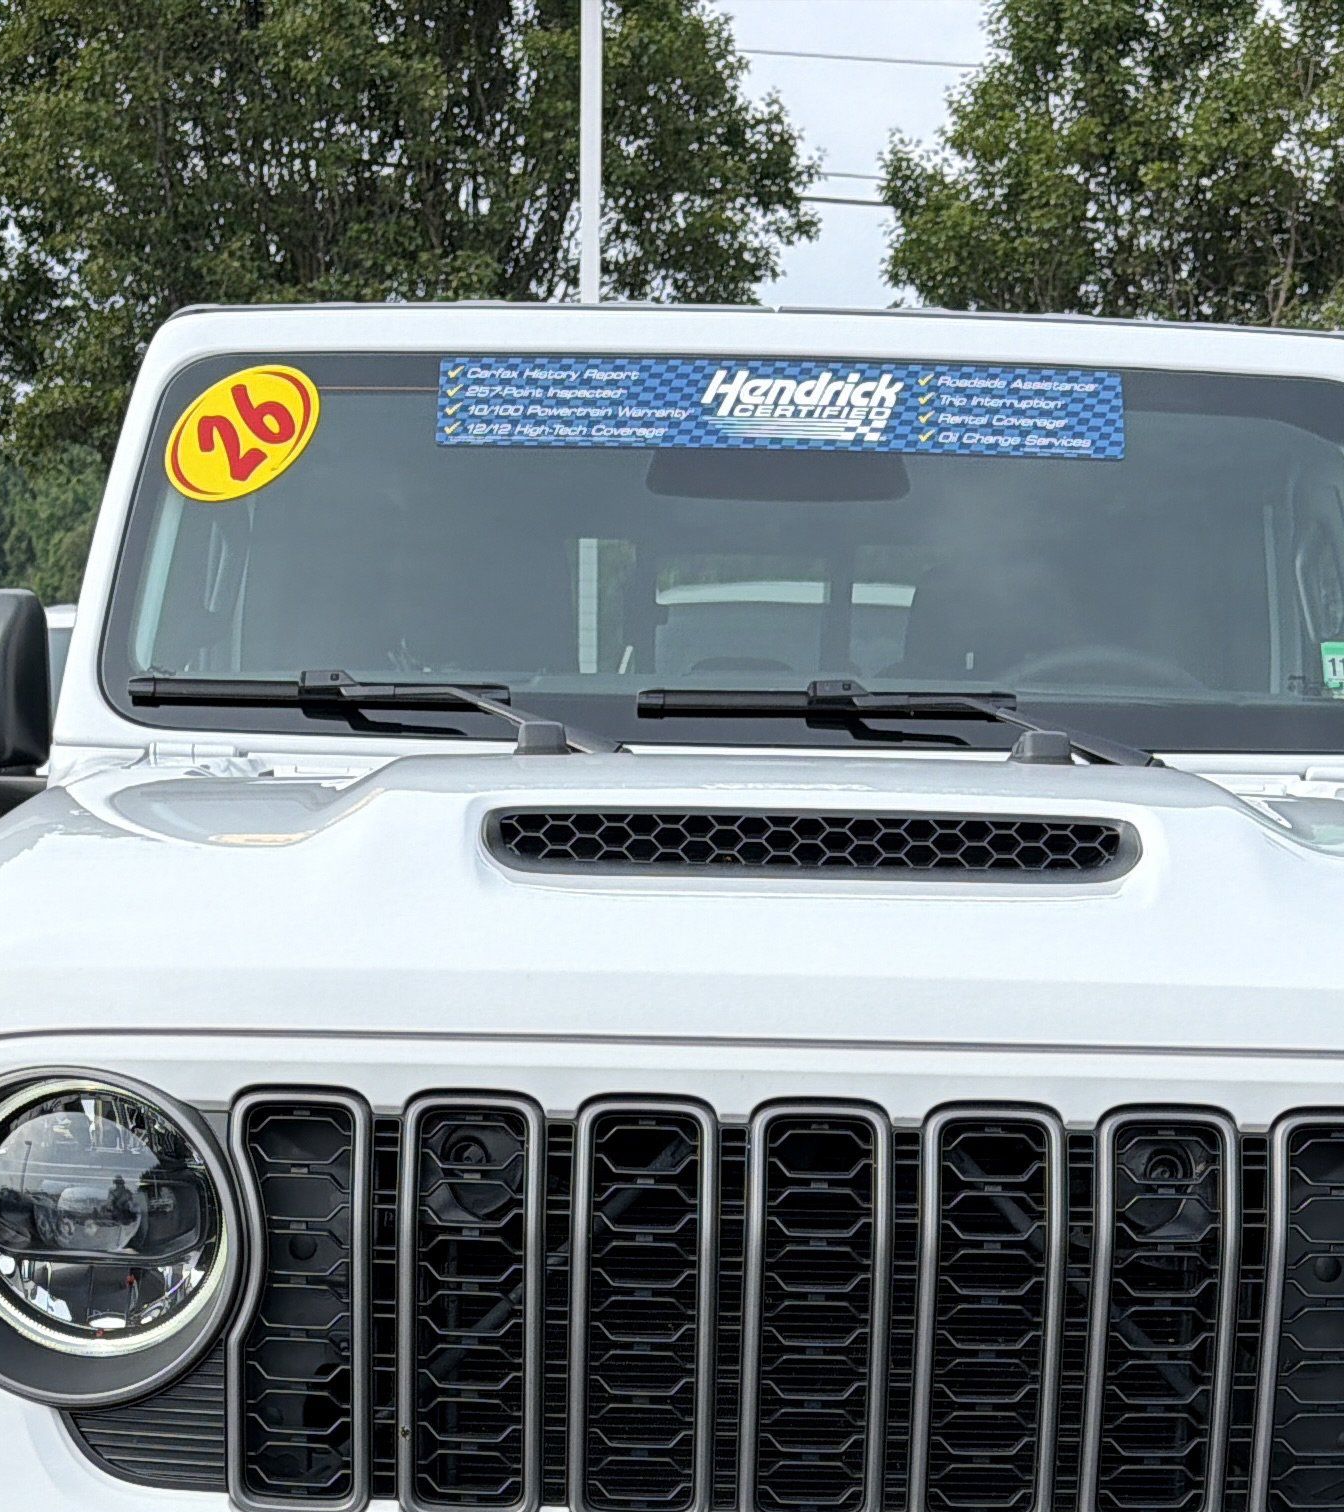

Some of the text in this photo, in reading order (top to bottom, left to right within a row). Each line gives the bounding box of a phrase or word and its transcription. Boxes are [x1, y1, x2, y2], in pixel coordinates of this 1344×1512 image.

[467, 367, 640, 382] Carfax History Report
[937, 376, 1006, 389] Roadside
[701, 369, 904, 417] Hendrick
[939, 395, 967, 407] Trip
[467, 404, 523, 416] 10/100
[527, 405, 613, 418] Powertrain
[732, 404, 892, 420] CERTIFIED
[938, 413, 988, 425] Rental
[197, 384, 296, 481] 26
[466, 423, 512, 435] 12/12
[514, 424, 587, 436] High-Tech
[938, 432, 1092, 447] Oil Change Services
